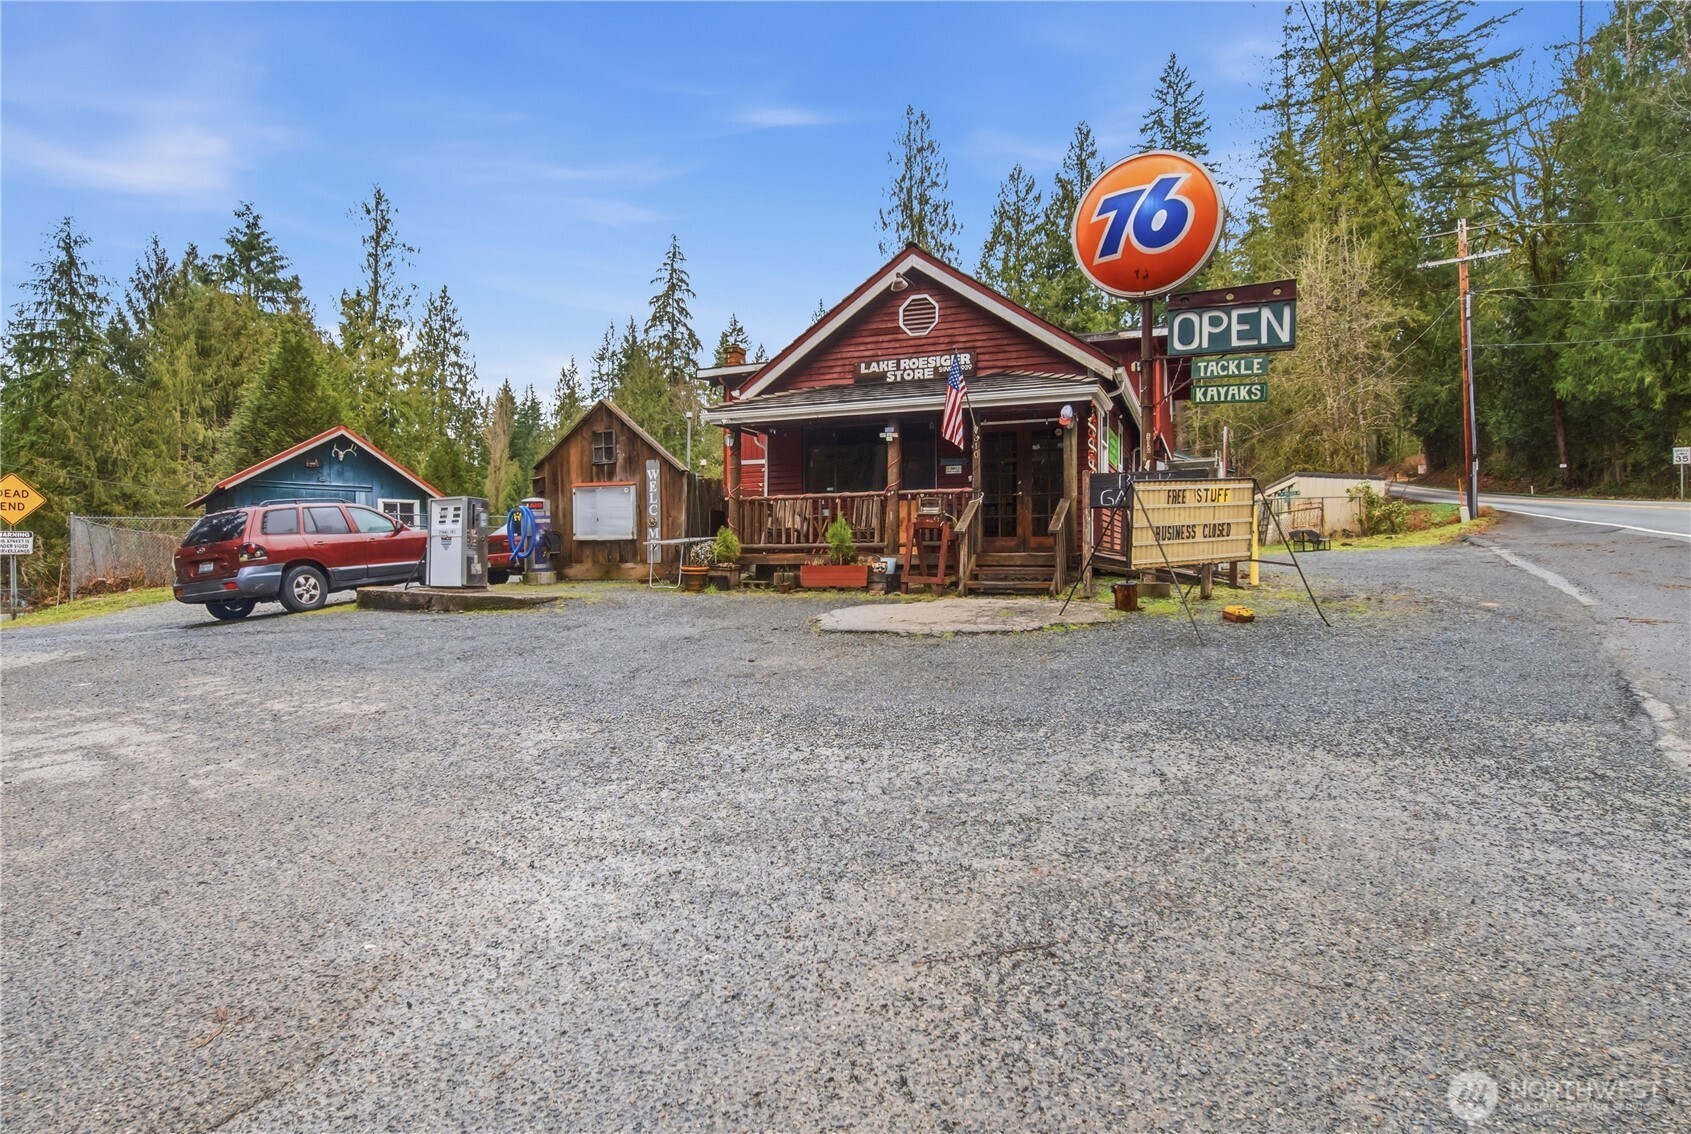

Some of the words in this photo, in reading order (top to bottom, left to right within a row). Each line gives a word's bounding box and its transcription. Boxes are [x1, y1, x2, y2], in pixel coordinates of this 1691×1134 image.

[1090, 172, 1195, 265] 76
[1172, 303, 1291, 351] OPEN
[860, 360, 897, 374] LAKE
[900, 353, 971, 370] ROESIGER
[1197, 358, 1263, 377] TACKLE
[886, 368, 934, 382] STORE
[1195, 385, 1262, 402] KAYAKS
[1167, 489, 1187, 505] FREE
[1196, 488, 1231, 503] STUFF
[1, 502, 26, 512] END
[1155, 523, 1197, 542] BUSINESS
[1202, 522, 1232, 539] CLOSED
